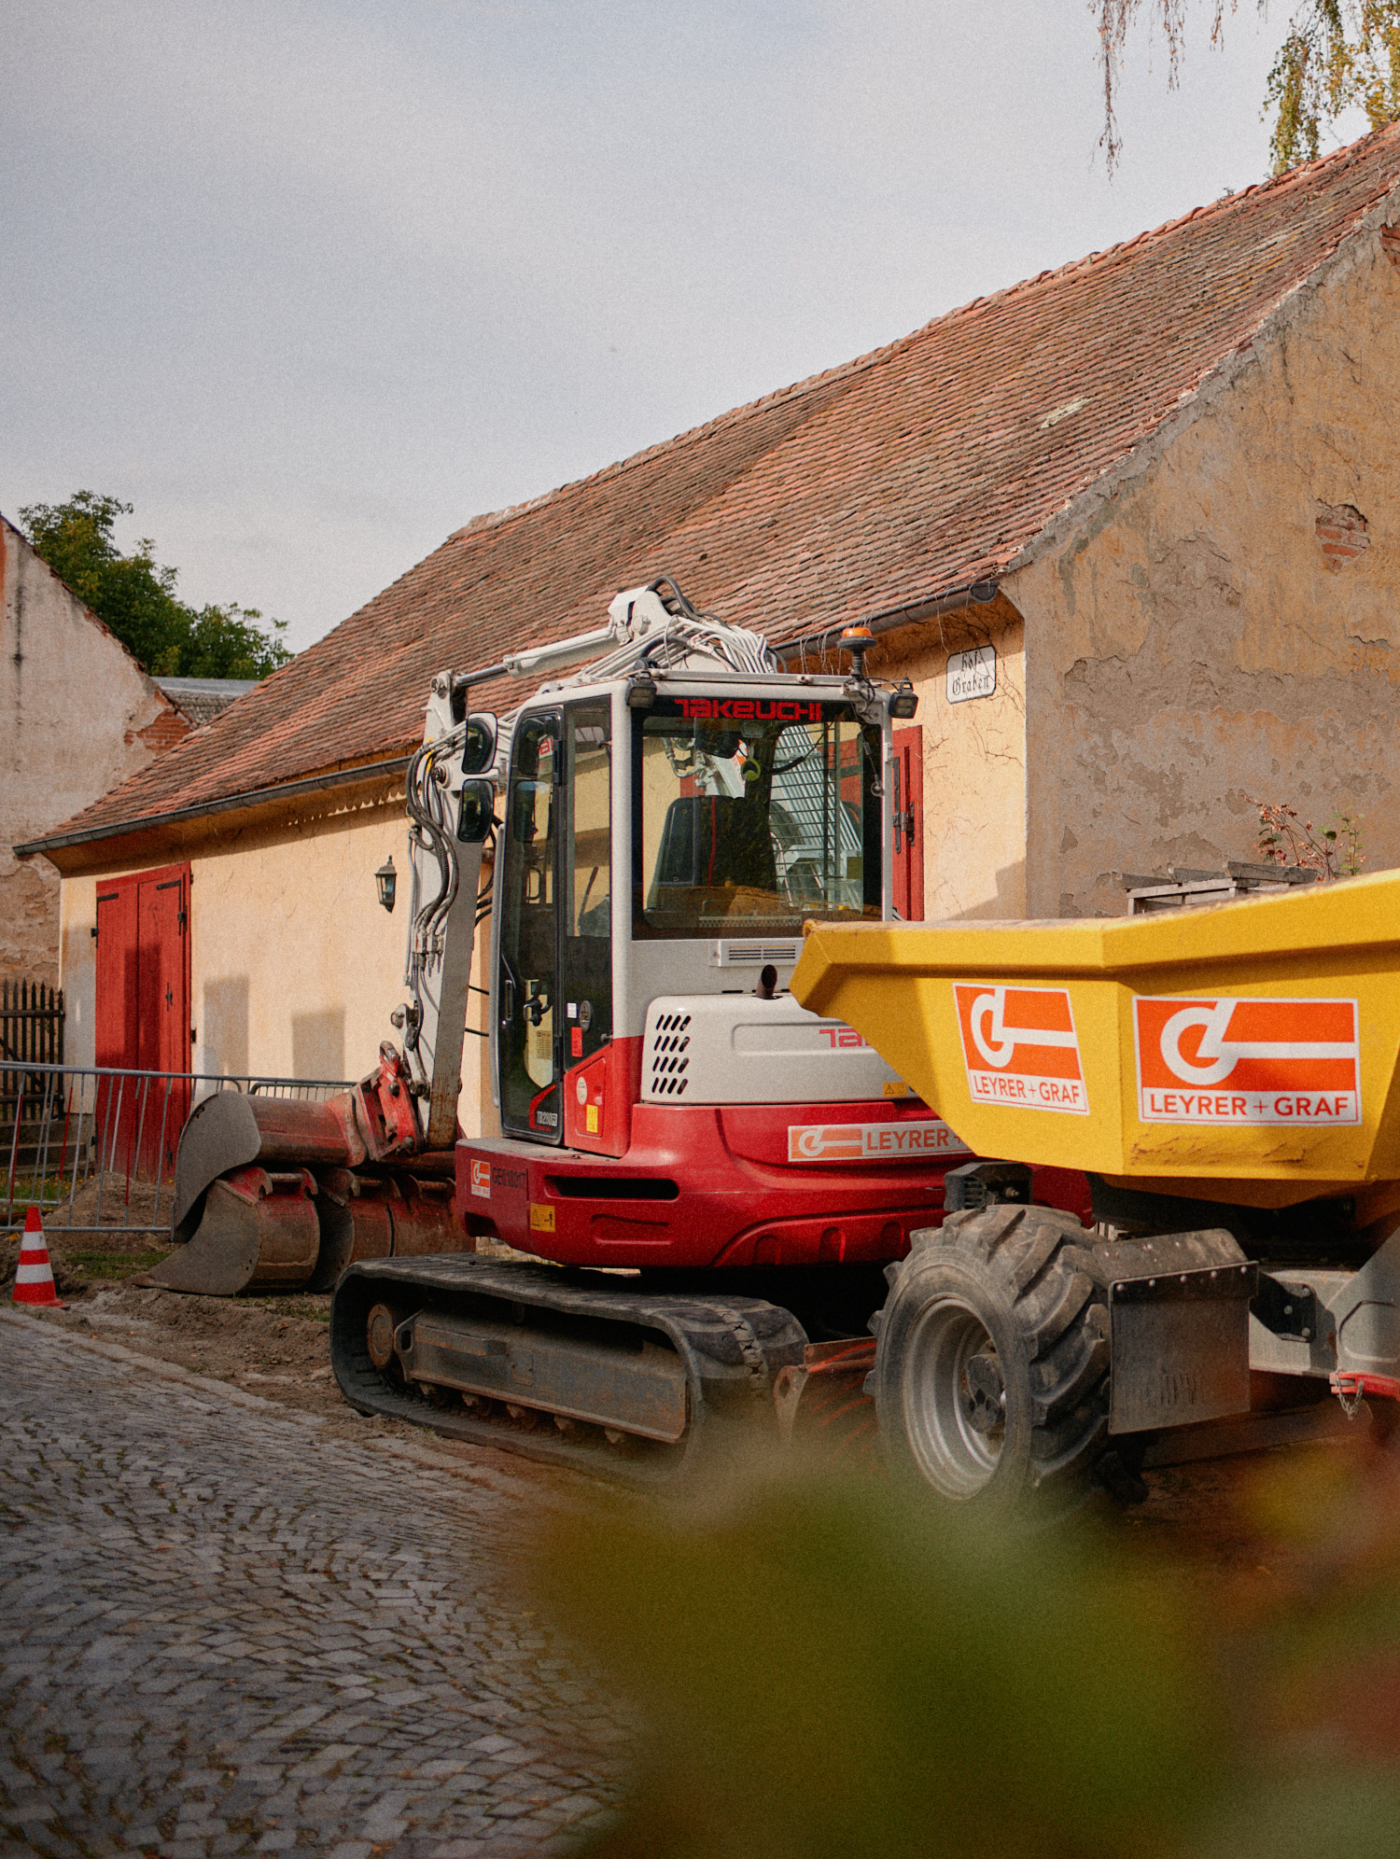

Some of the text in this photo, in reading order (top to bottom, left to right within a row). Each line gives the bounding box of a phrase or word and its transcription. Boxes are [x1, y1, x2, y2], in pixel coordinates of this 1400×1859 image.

[952, 674, 990, 696] Graben
[973, 1075, 1027, 1099] LEYRER
[1039, 1081, 1080, 1104] GRAF
[1150, 1093, 1248, 1116] LEYRER
[1274, 1096, 1348, 1116] GRAF
[866, 1128, 950, 1151] LEYRER
